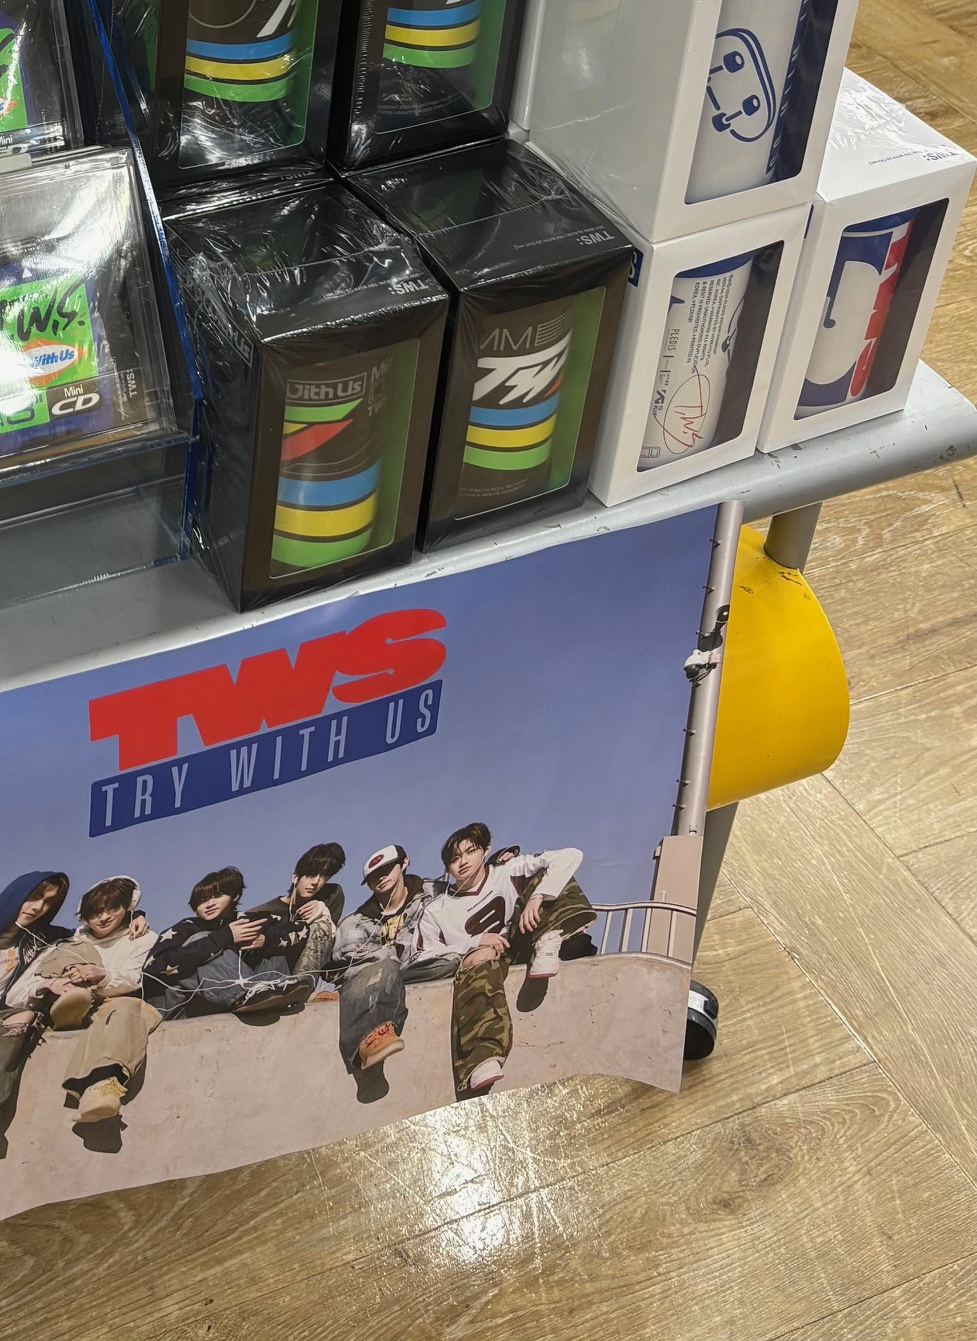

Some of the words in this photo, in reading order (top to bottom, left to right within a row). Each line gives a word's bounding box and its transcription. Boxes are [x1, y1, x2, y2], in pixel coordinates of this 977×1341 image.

[580, 230, 616, 246] TWS:
[388, 279, 430, 295] TWS:
[666, 327, 680, 352] PLEDIS
[58, 349, 74, 362] Us
[64, 383, 83, 398] Mini
[127, 369, 138, 397] TWS:
[337, 380, 362, 397] Us
[51, 393, 100, 416] CD
[88, 608, 448, 772] TWS
[101, 765, 192, 829] TRY
[230, 717, 348, 794] WITH
[385, 686, 436, 746] US
